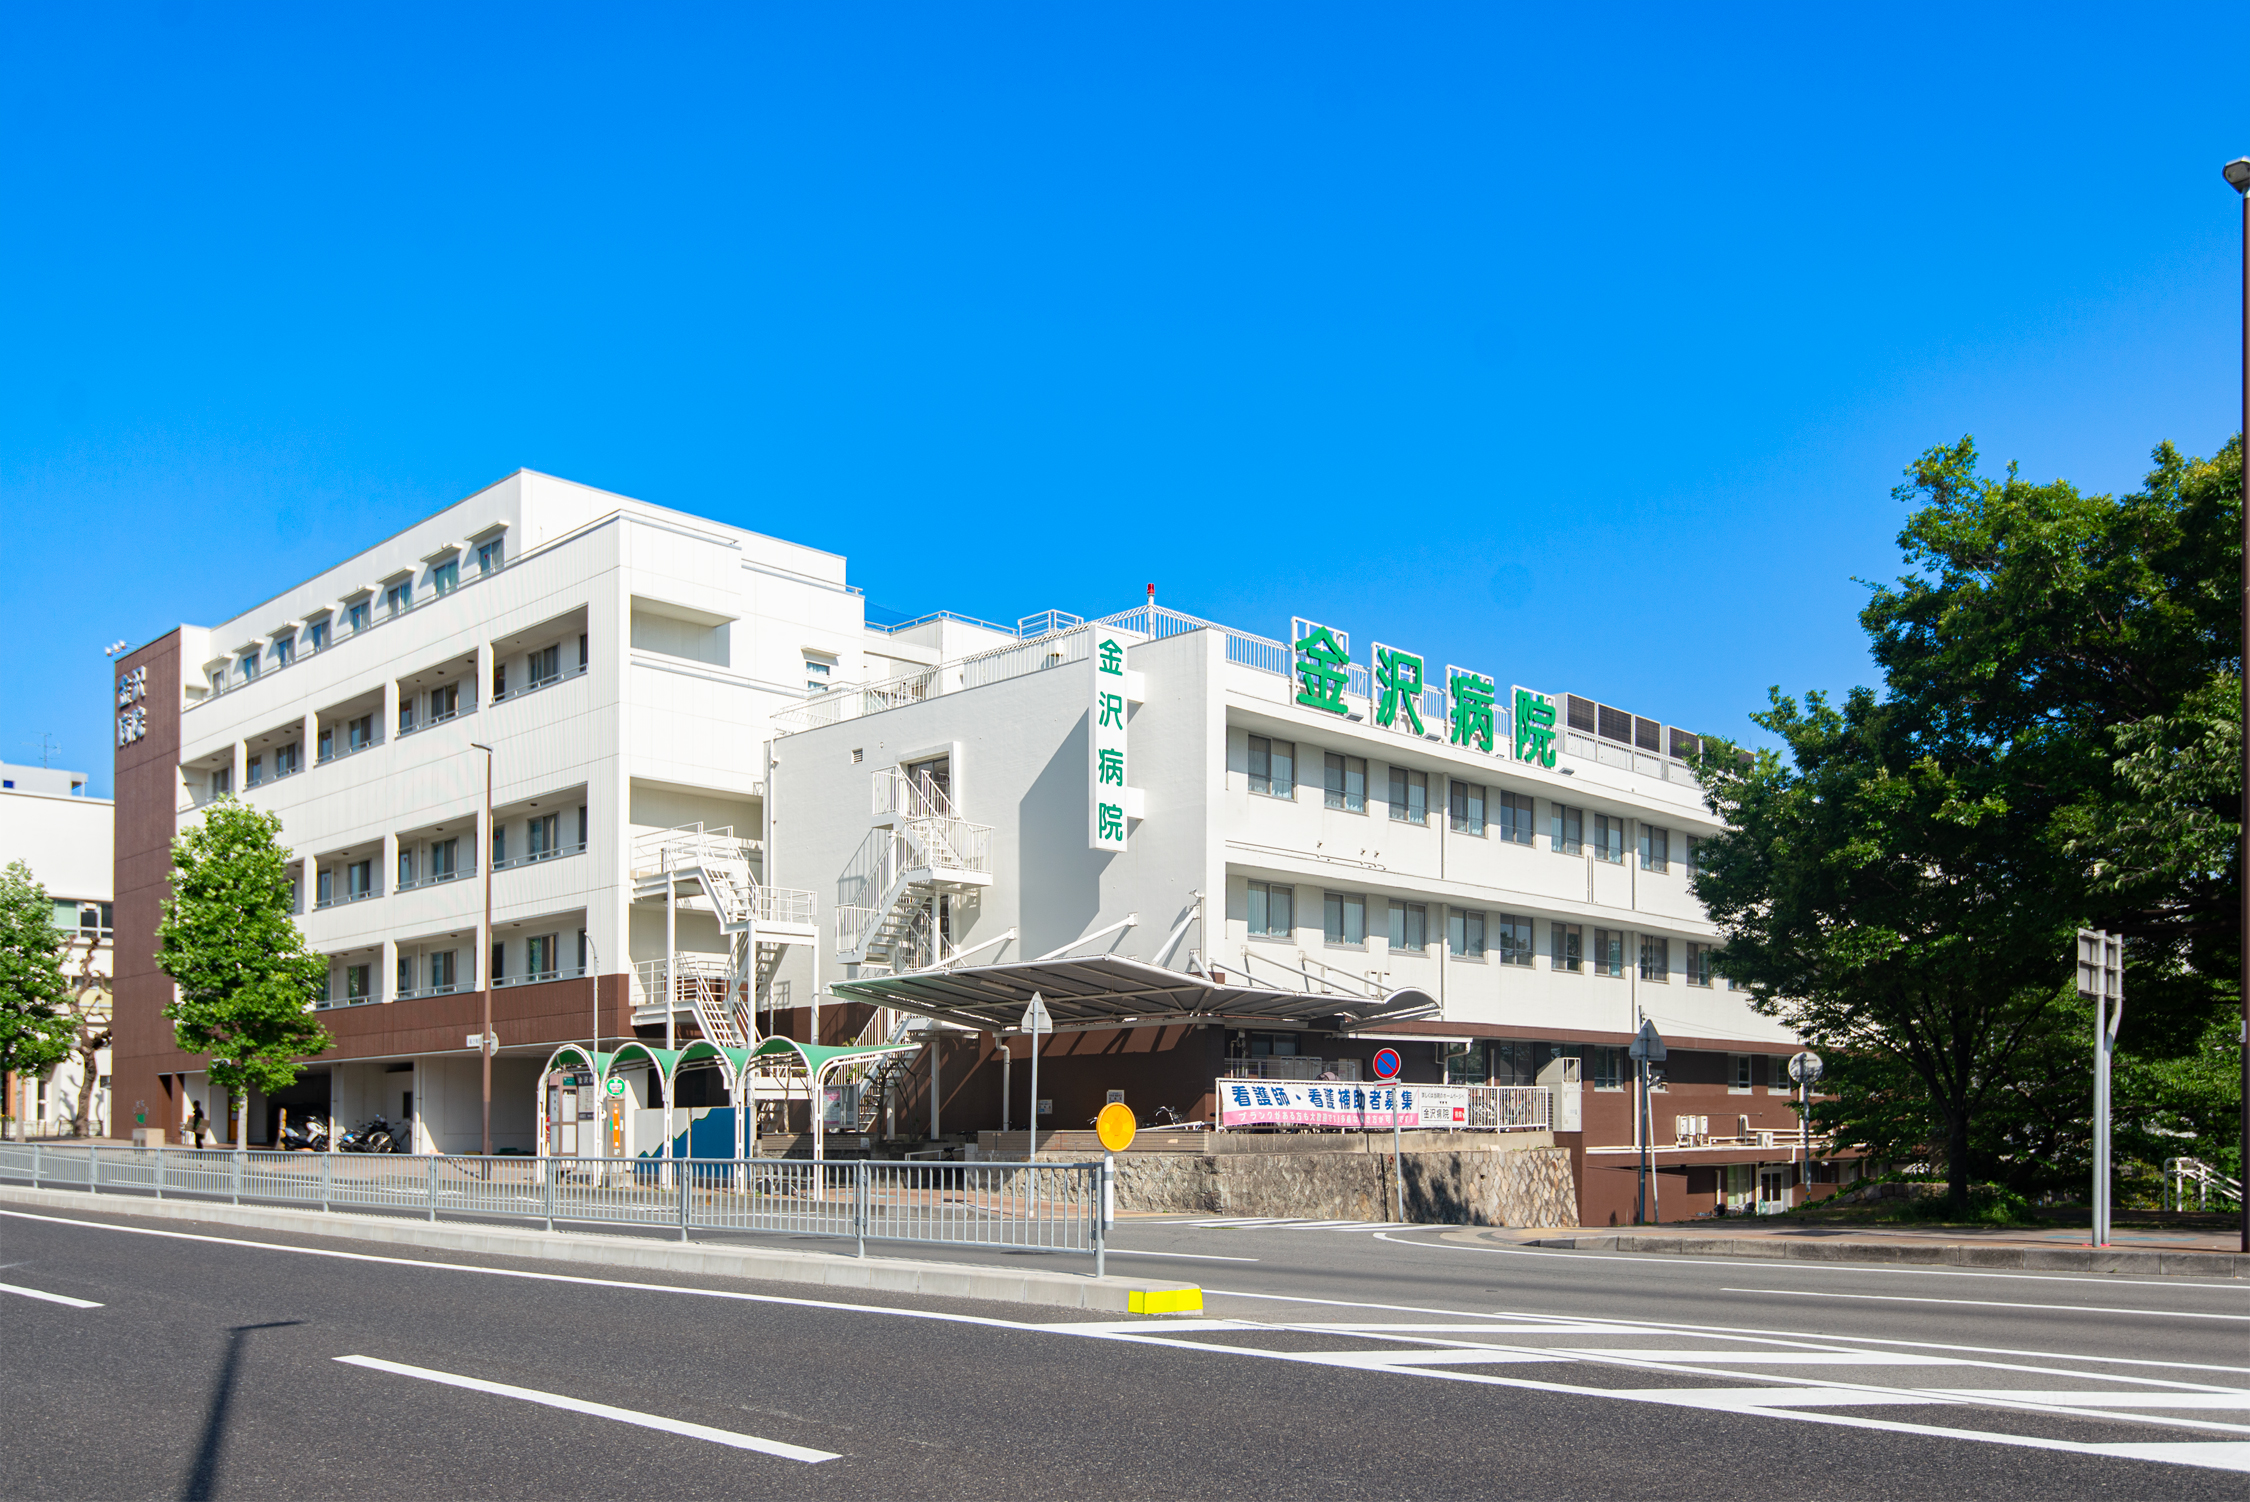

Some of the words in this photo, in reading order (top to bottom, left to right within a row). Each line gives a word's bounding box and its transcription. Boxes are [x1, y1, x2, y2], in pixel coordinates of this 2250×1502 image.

[118, 665, 147, 708] 金沢
[1296, 626, 1556, 768] 金沢病院
[117, 705, 147, 747] 病院
[1098, 638, 1124, 842] 金沢病院
[1231, 1085, 1412, 1110] 看護師・看護補助者募集
[1238, 1111, 1414, 1124] ブランクがある方も大歓迎です!多様なき方が可です!
[1423, 1108, 1450, 1119] 金沢病院
